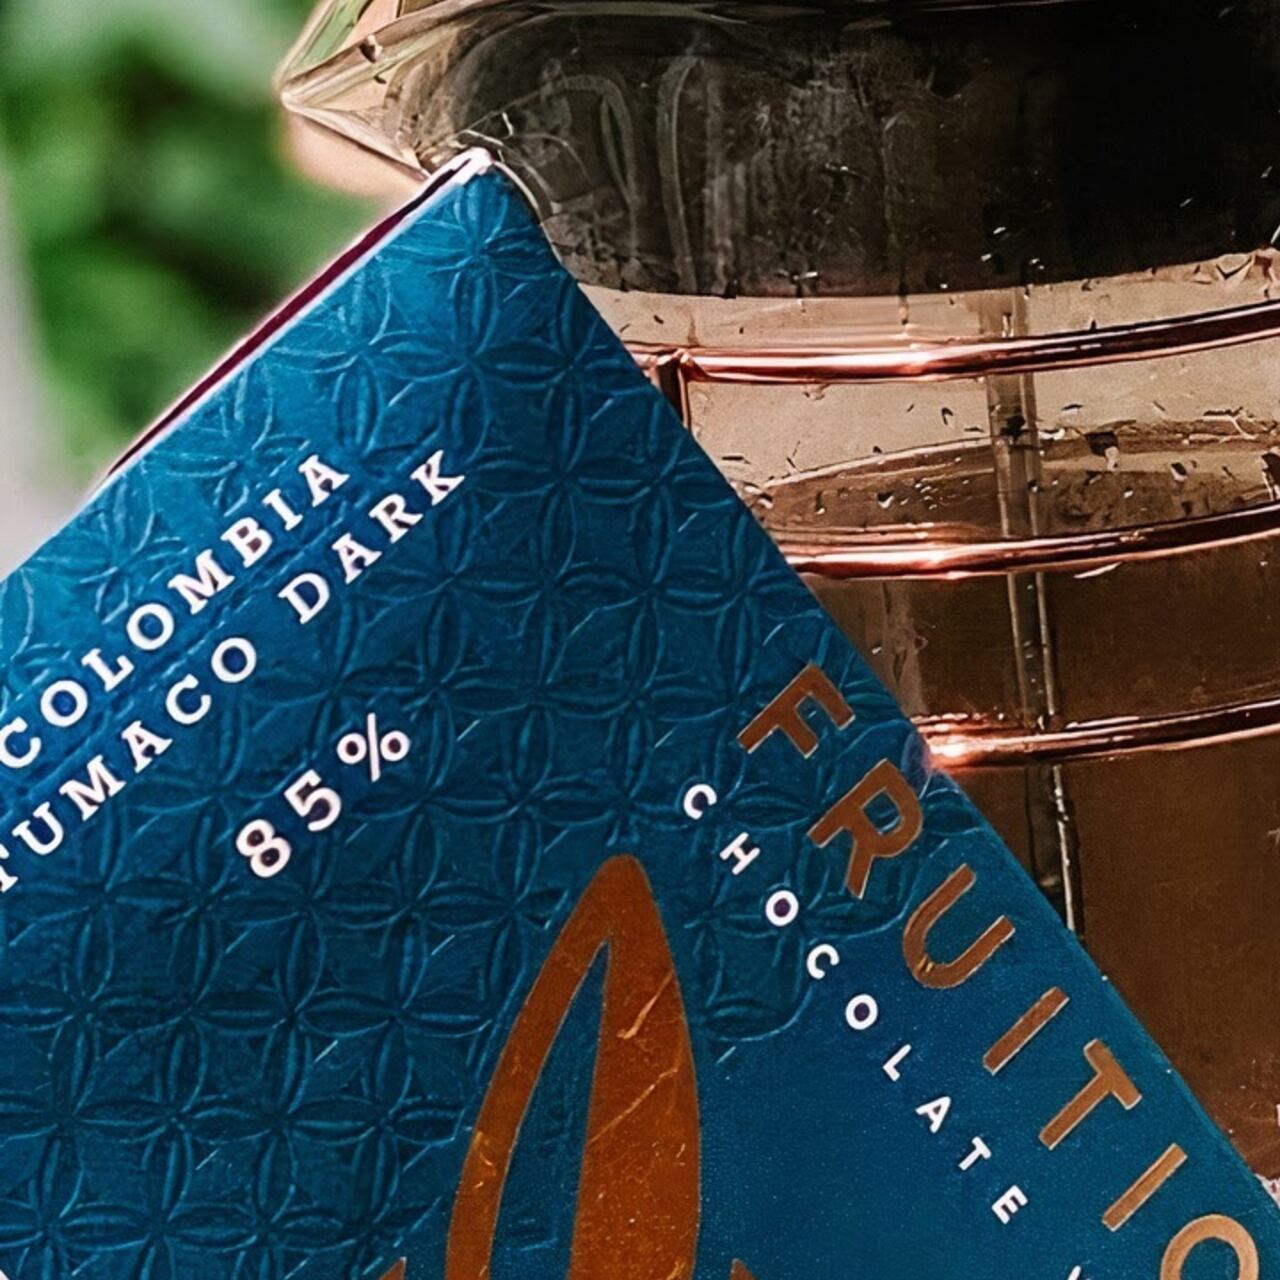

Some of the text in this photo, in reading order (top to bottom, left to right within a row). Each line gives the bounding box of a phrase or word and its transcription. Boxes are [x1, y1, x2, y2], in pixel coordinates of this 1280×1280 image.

[0, 454, 349, 768] COLOMBIA
[277, 449, 466, 624] DARK
[683, 783, 1028, 1224] CHOCOLATE
